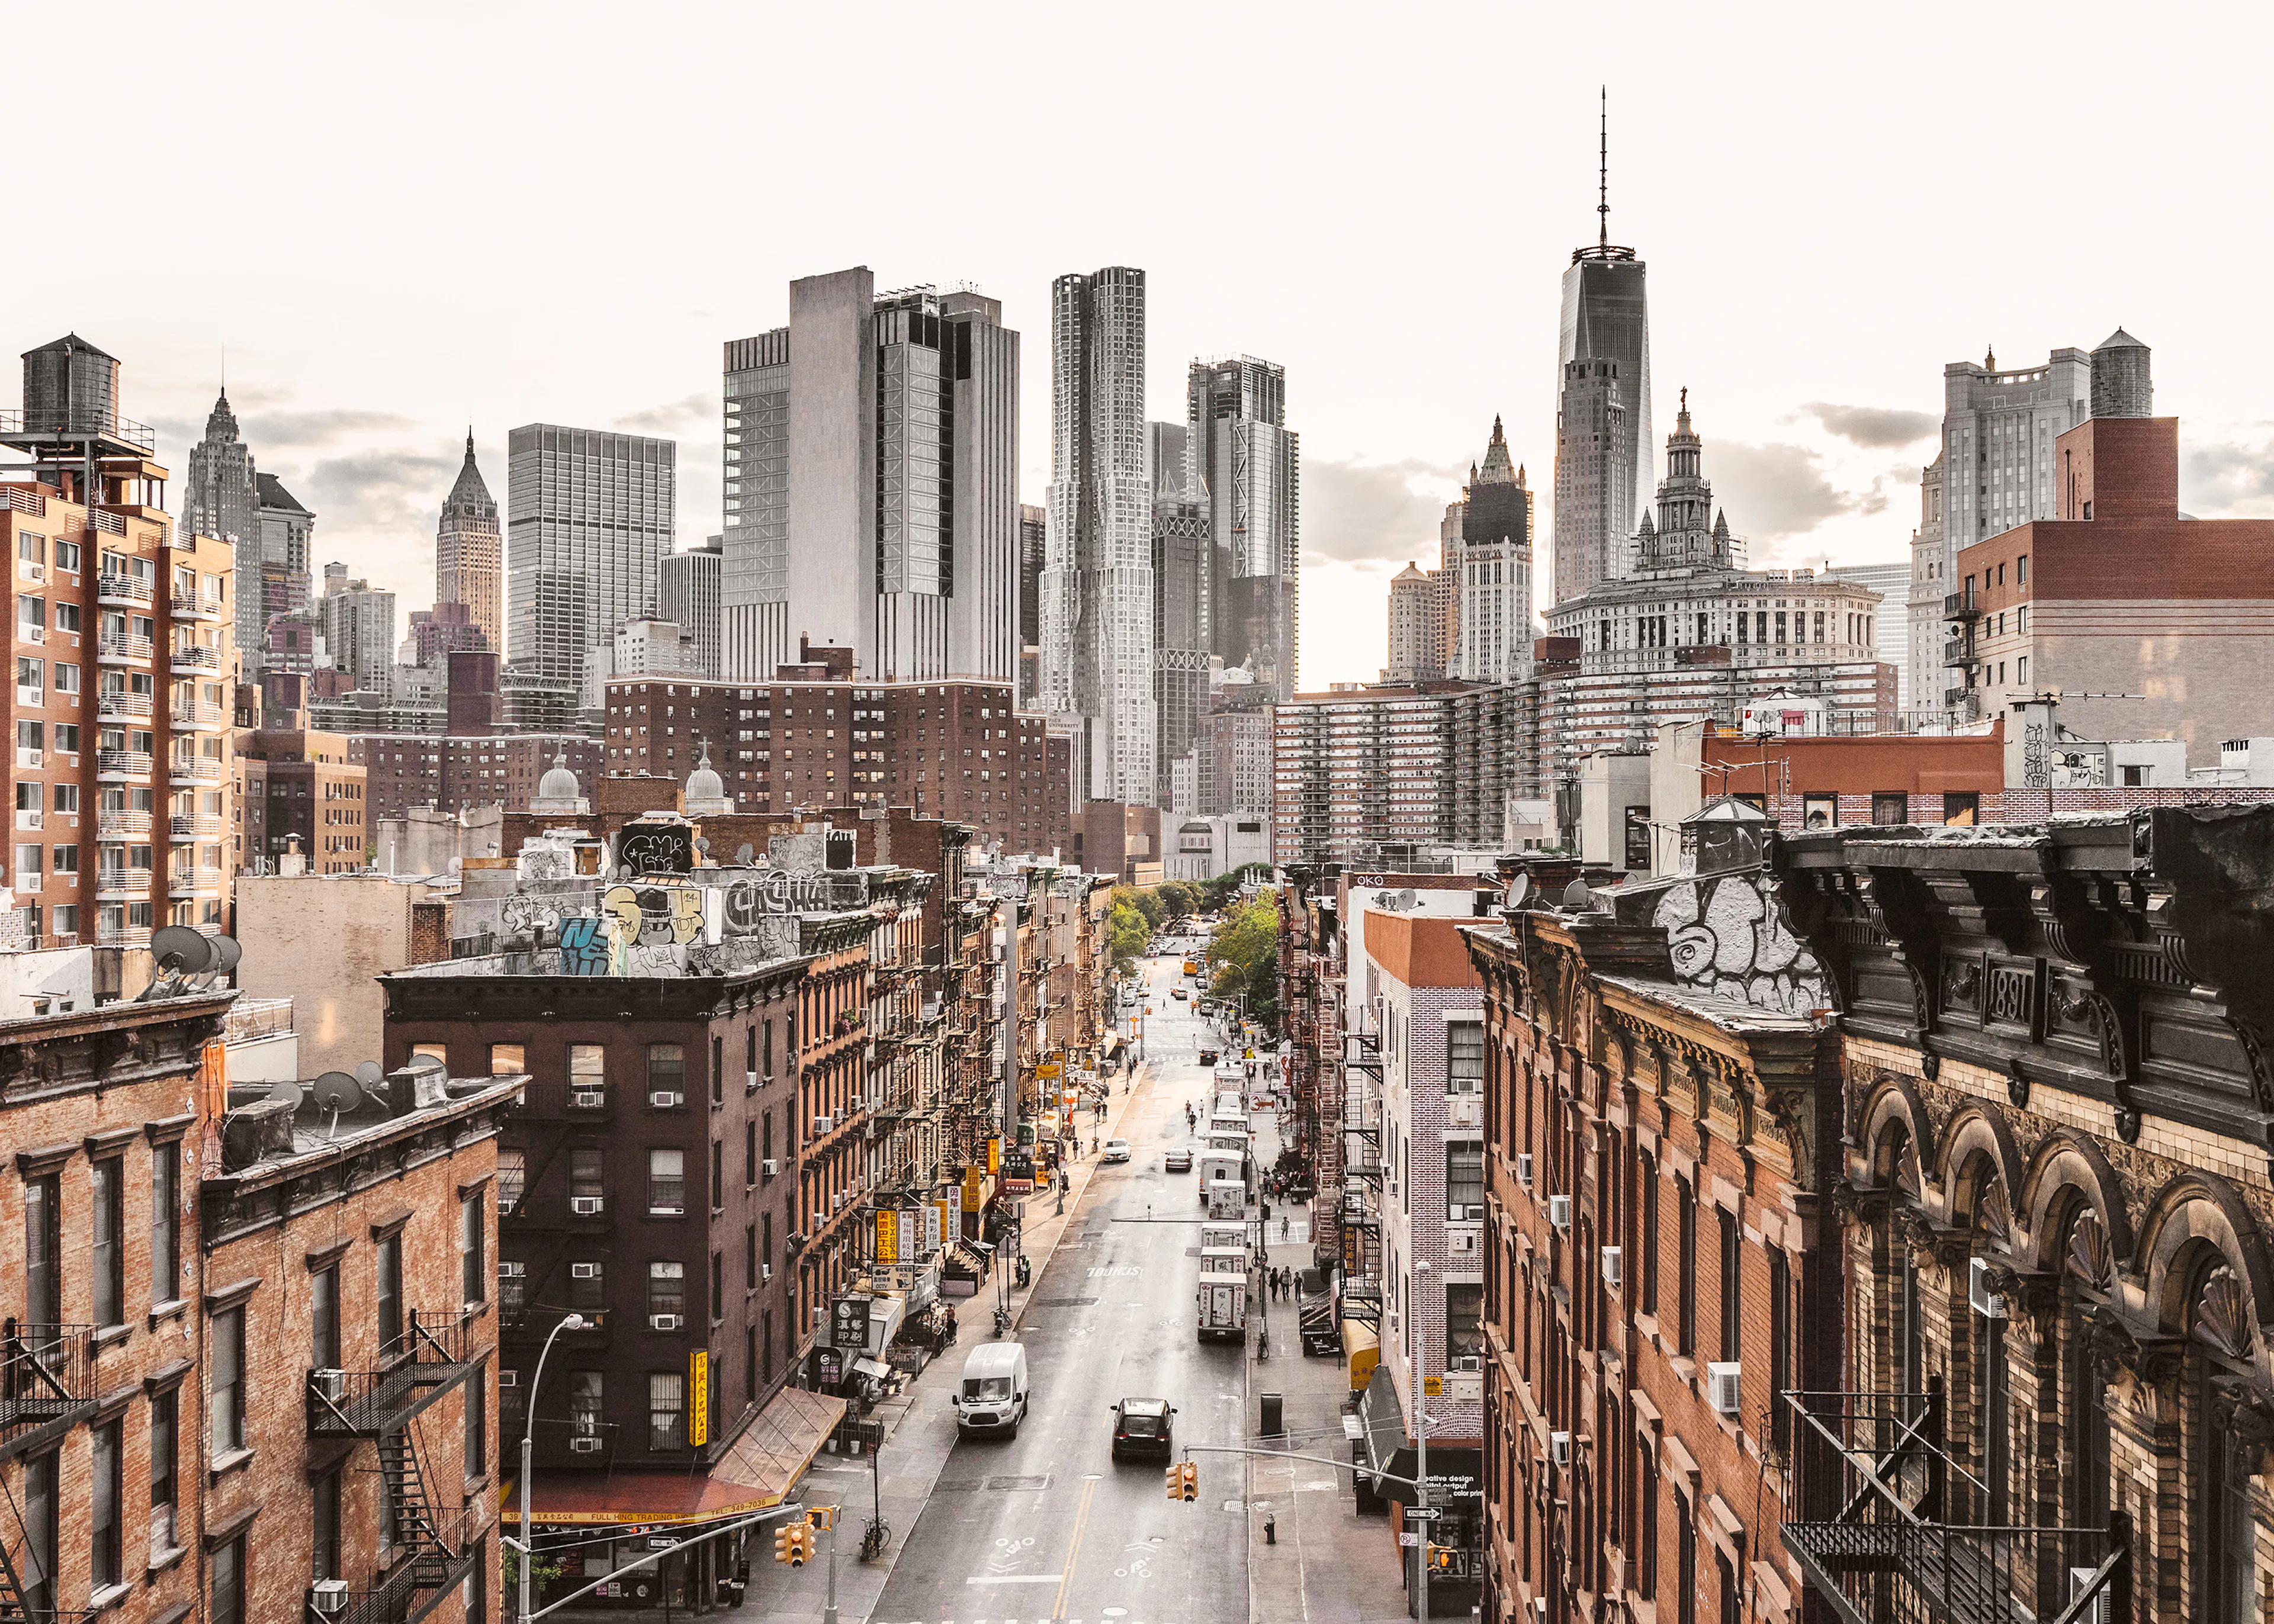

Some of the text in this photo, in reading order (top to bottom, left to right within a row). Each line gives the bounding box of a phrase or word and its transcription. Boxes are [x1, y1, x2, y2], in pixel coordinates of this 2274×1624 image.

[1357, 875, 1383, 886] OKO
[1990, 970, 2028, 1024] 1891
[838, 1331, 862, 1342] 印刷
[1448, 1475, 1474, 1483] design
[731, 1498, 766, 1513] 349-7036
